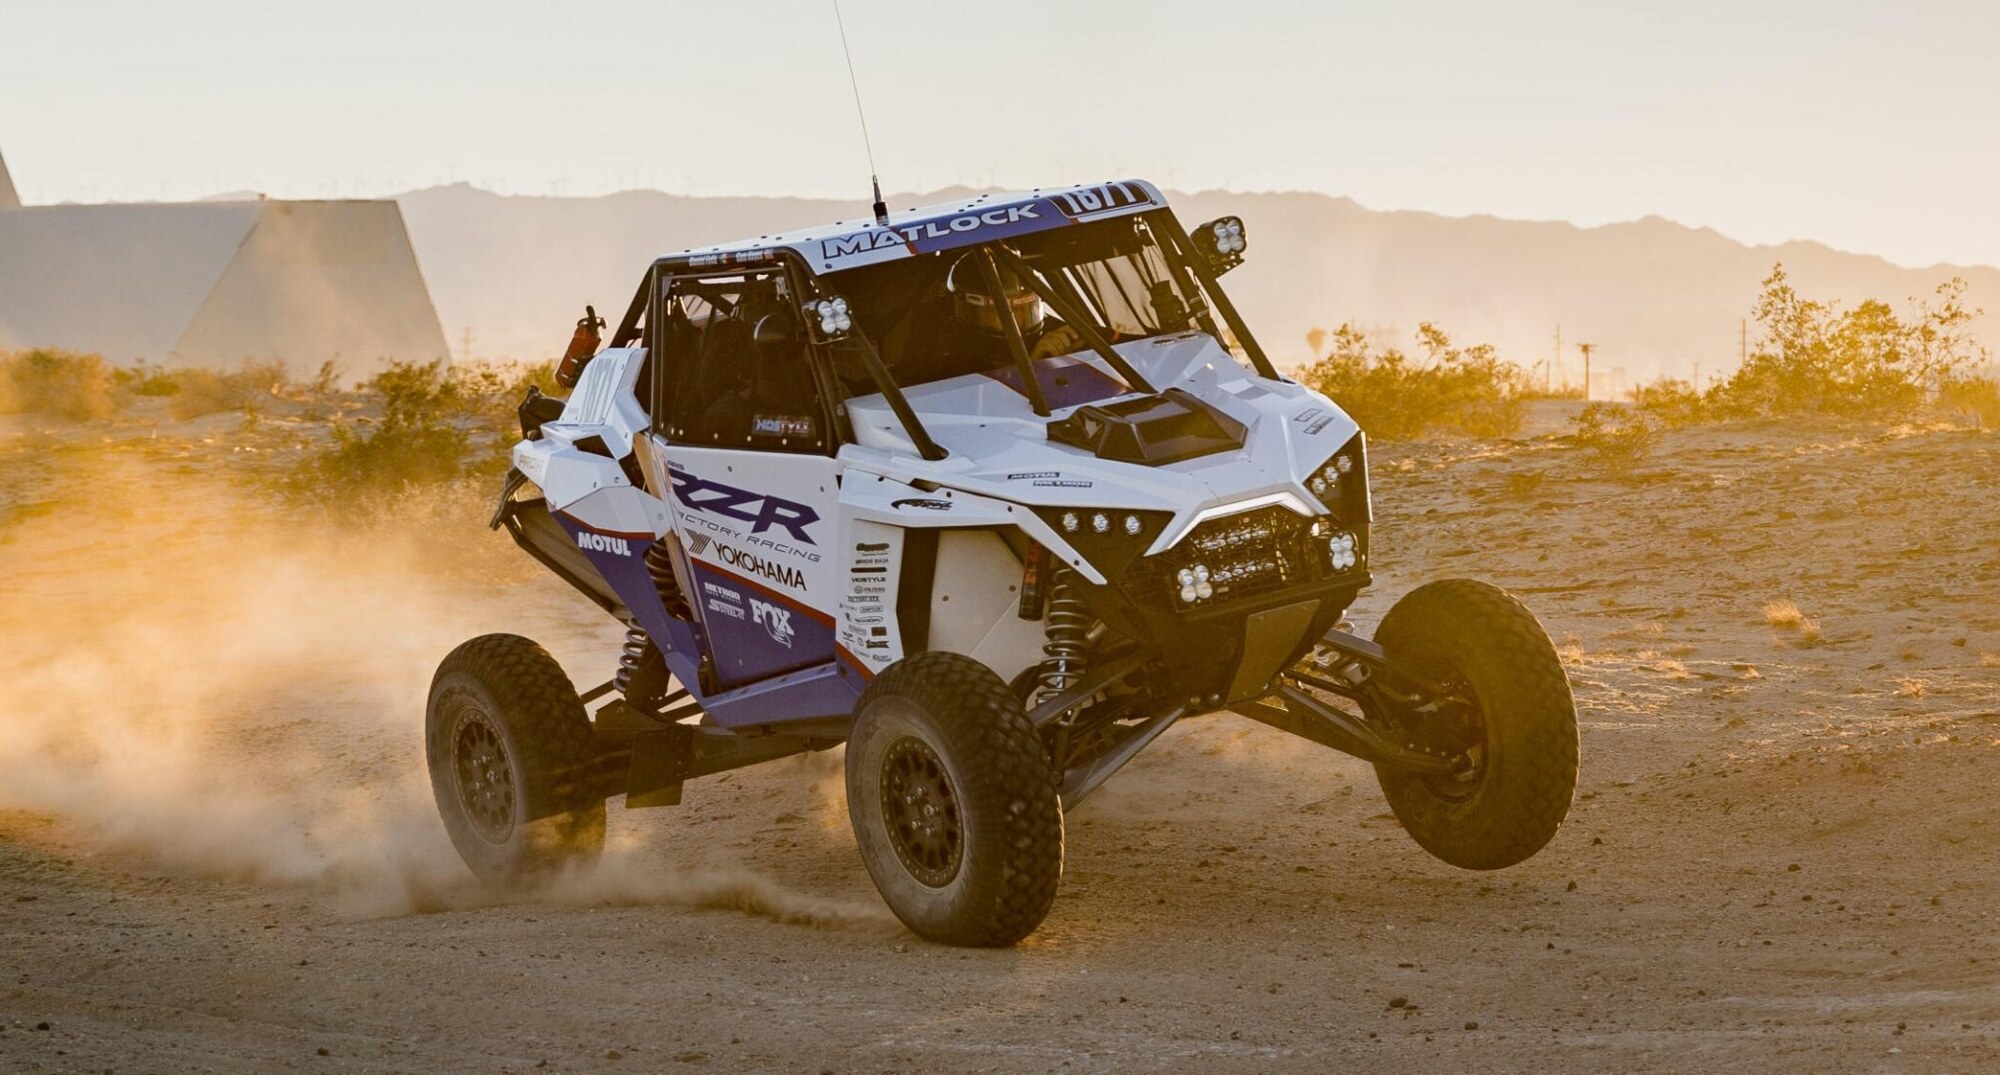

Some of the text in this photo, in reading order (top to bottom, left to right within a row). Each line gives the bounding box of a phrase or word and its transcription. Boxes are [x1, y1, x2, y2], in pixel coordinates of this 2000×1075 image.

[822, 203, 1040, 259] MATLOCK
[667, 467, 821, 546] RZR
[577, 531, 631, 556] MOTUL
[676, 510, 822, 563] ACTORY RACING
[712, 540, 807, 591] YOKOHAMA
[704, 582, 741, 601] METHOD
[749, 598, 795, 648] FOX
